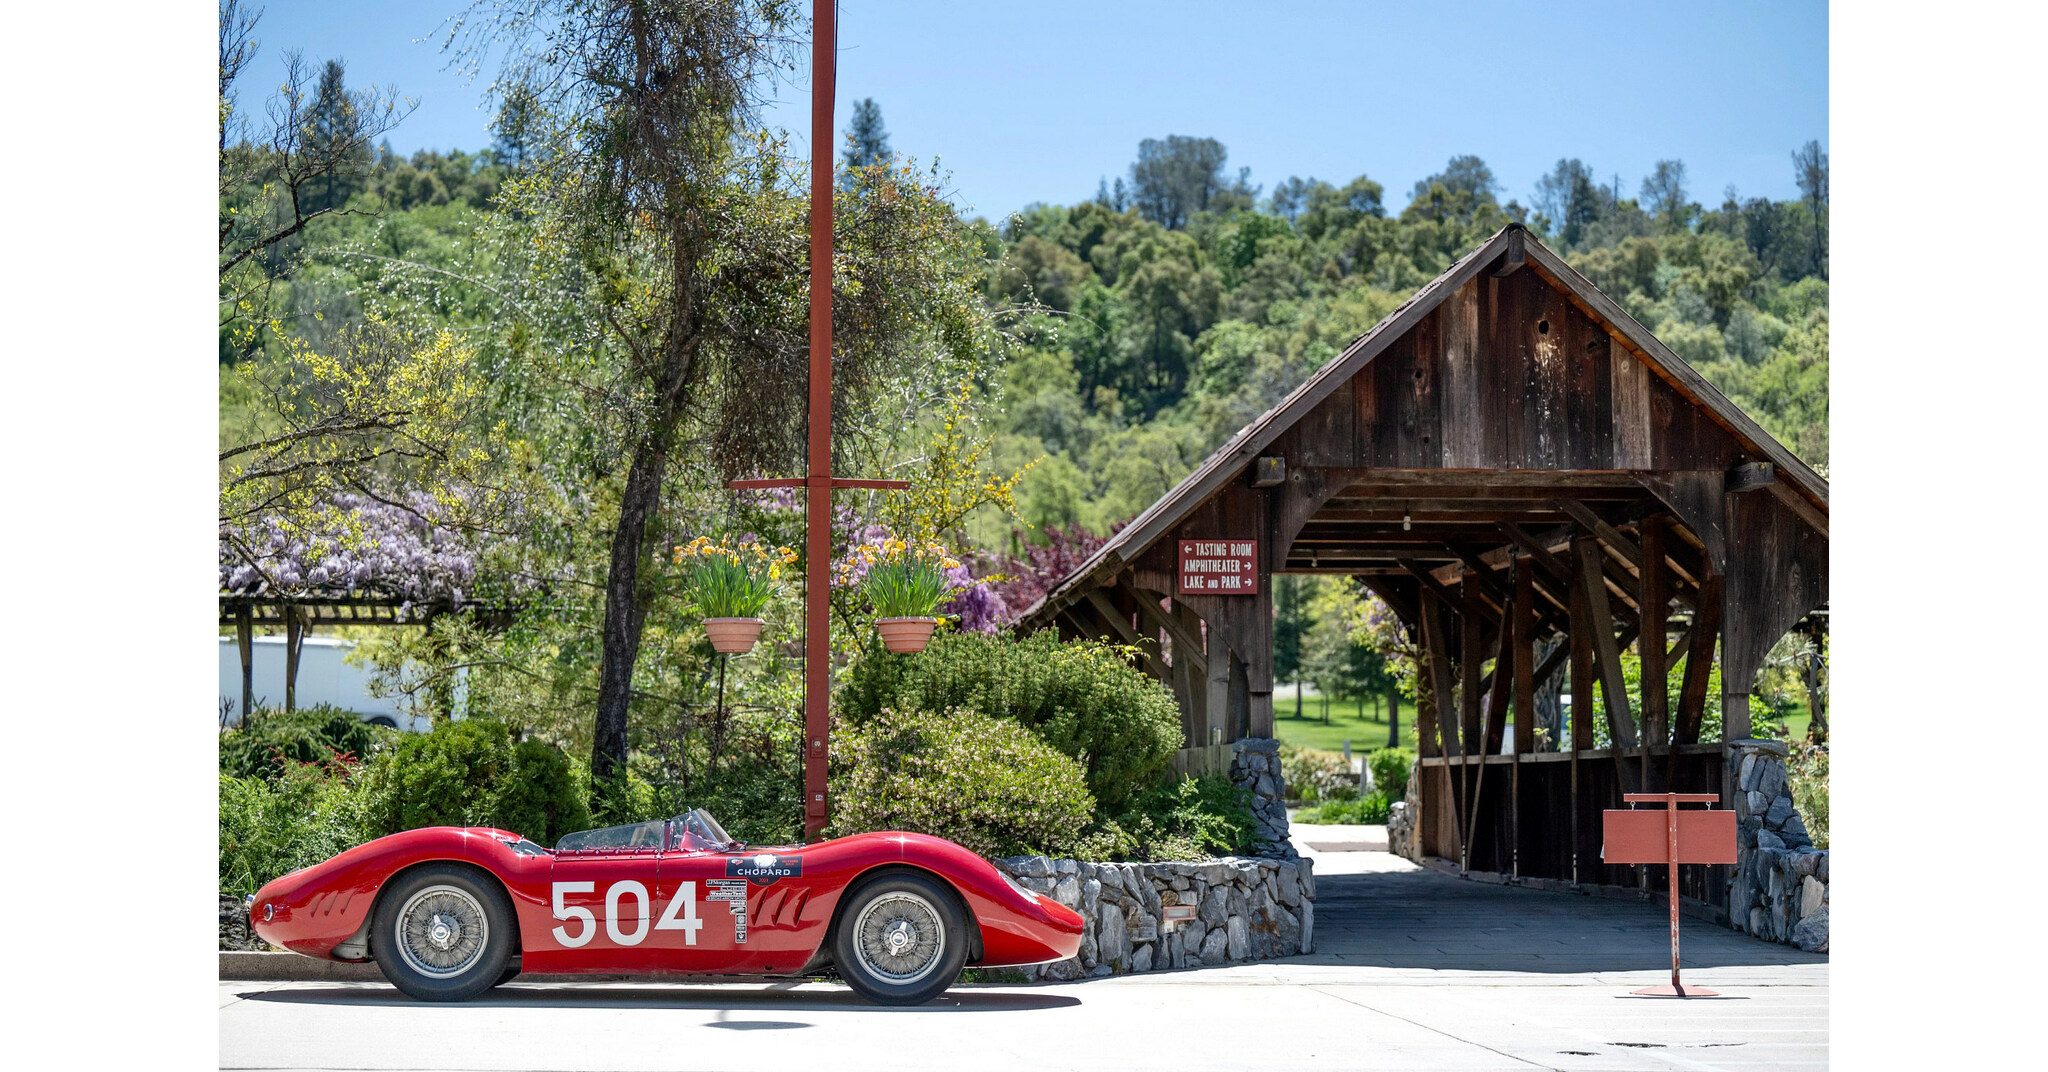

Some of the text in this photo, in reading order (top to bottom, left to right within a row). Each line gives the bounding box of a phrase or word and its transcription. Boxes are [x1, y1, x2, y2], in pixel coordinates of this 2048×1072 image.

[1196, 543, 1252, 557] TASTING ROOM
[1184, 559, 1240, 573] AMPHITHEATER
[1184, 575, 1241, 589] LAKE AND PARK
[737, 868, 791, 876] CHOPARD
[551, 880, 703, 948] 504
